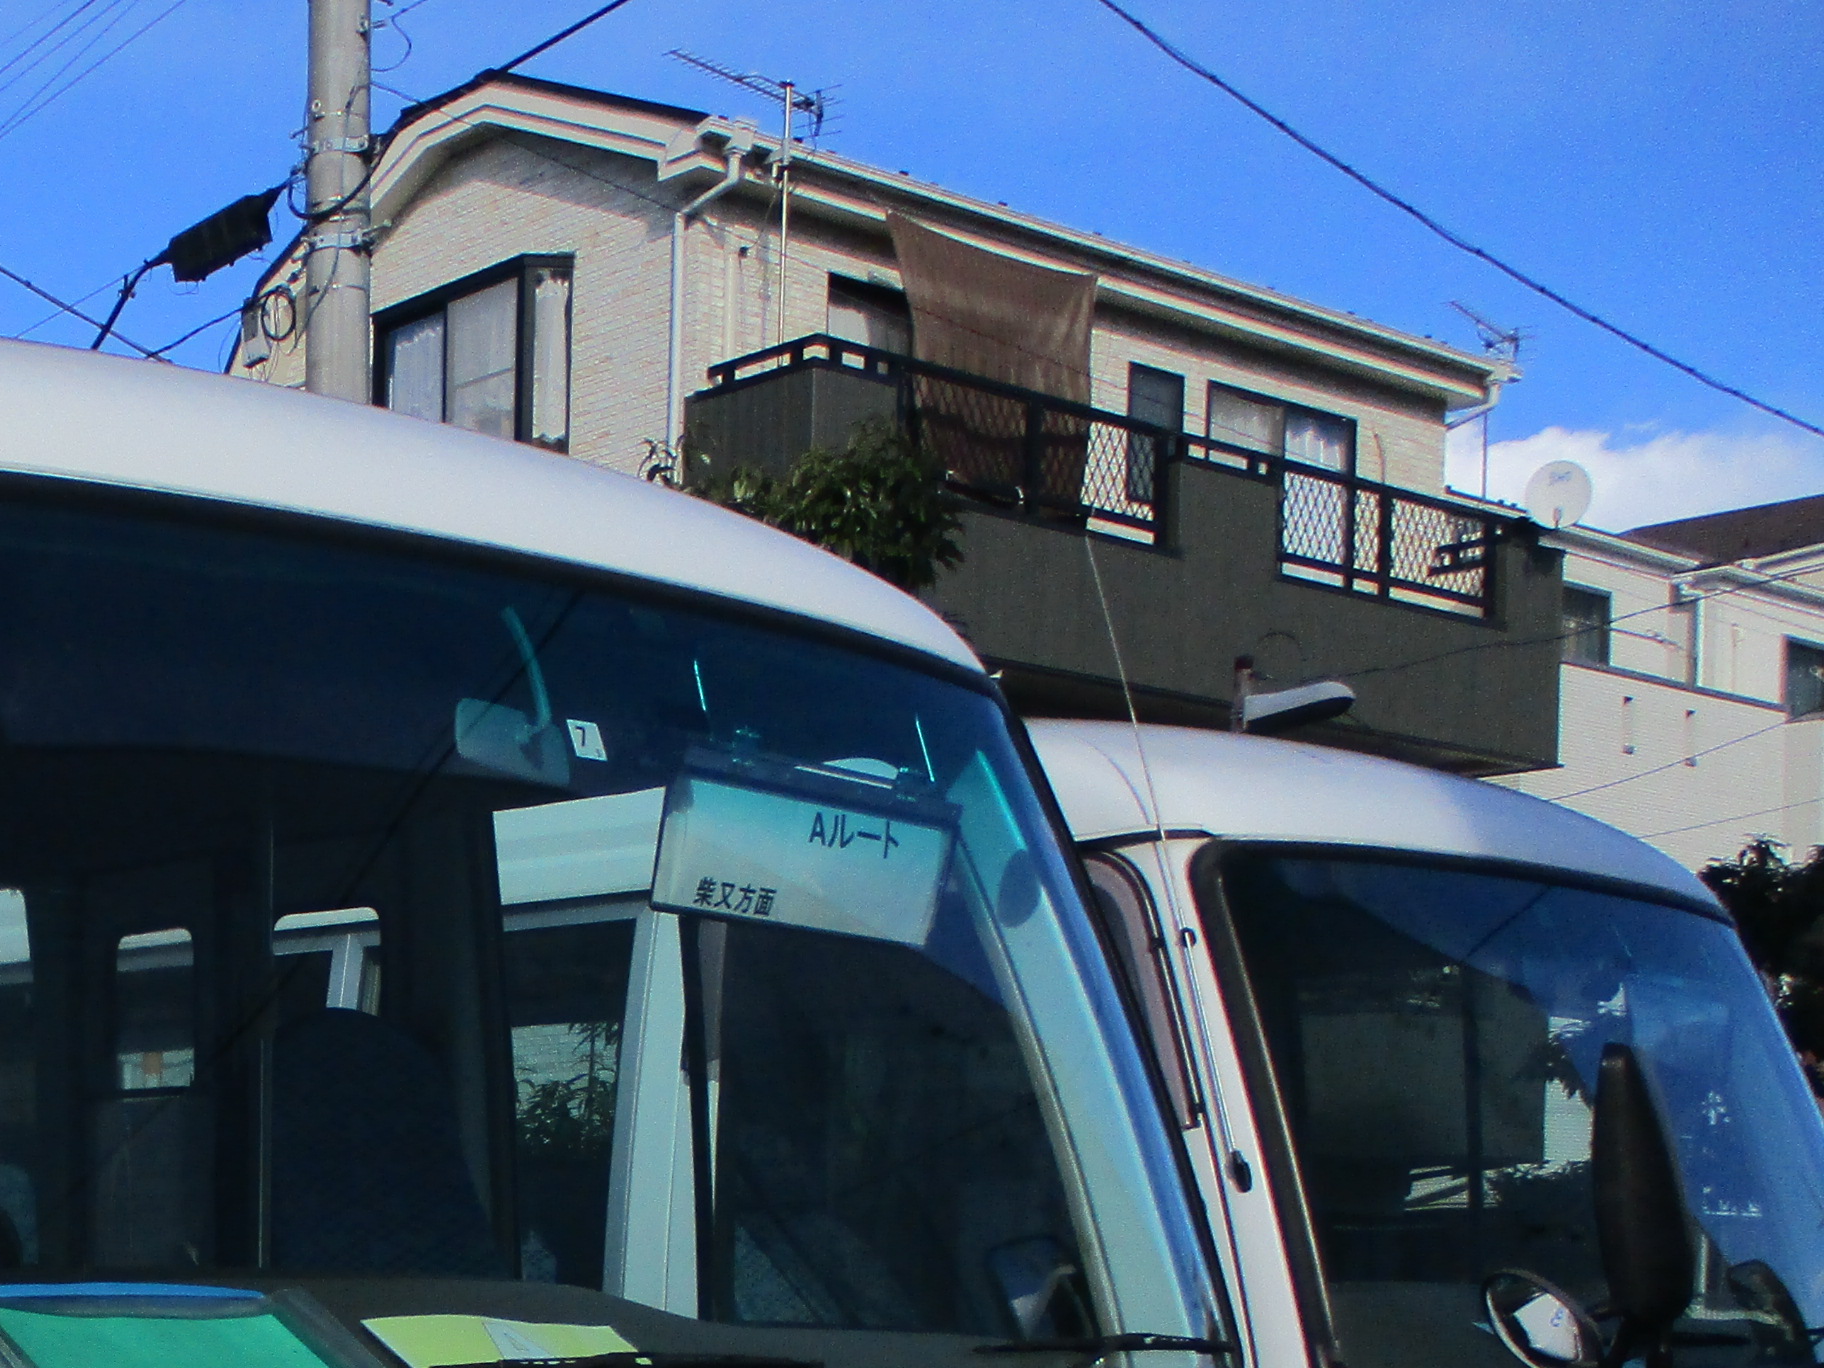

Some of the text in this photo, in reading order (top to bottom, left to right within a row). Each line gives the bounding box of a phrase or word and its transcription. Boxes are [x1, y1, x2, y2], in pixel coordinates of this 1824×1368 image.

[808, 811, 899, 859] Aルート
[693, 876, 777, 916] 柴又方面
